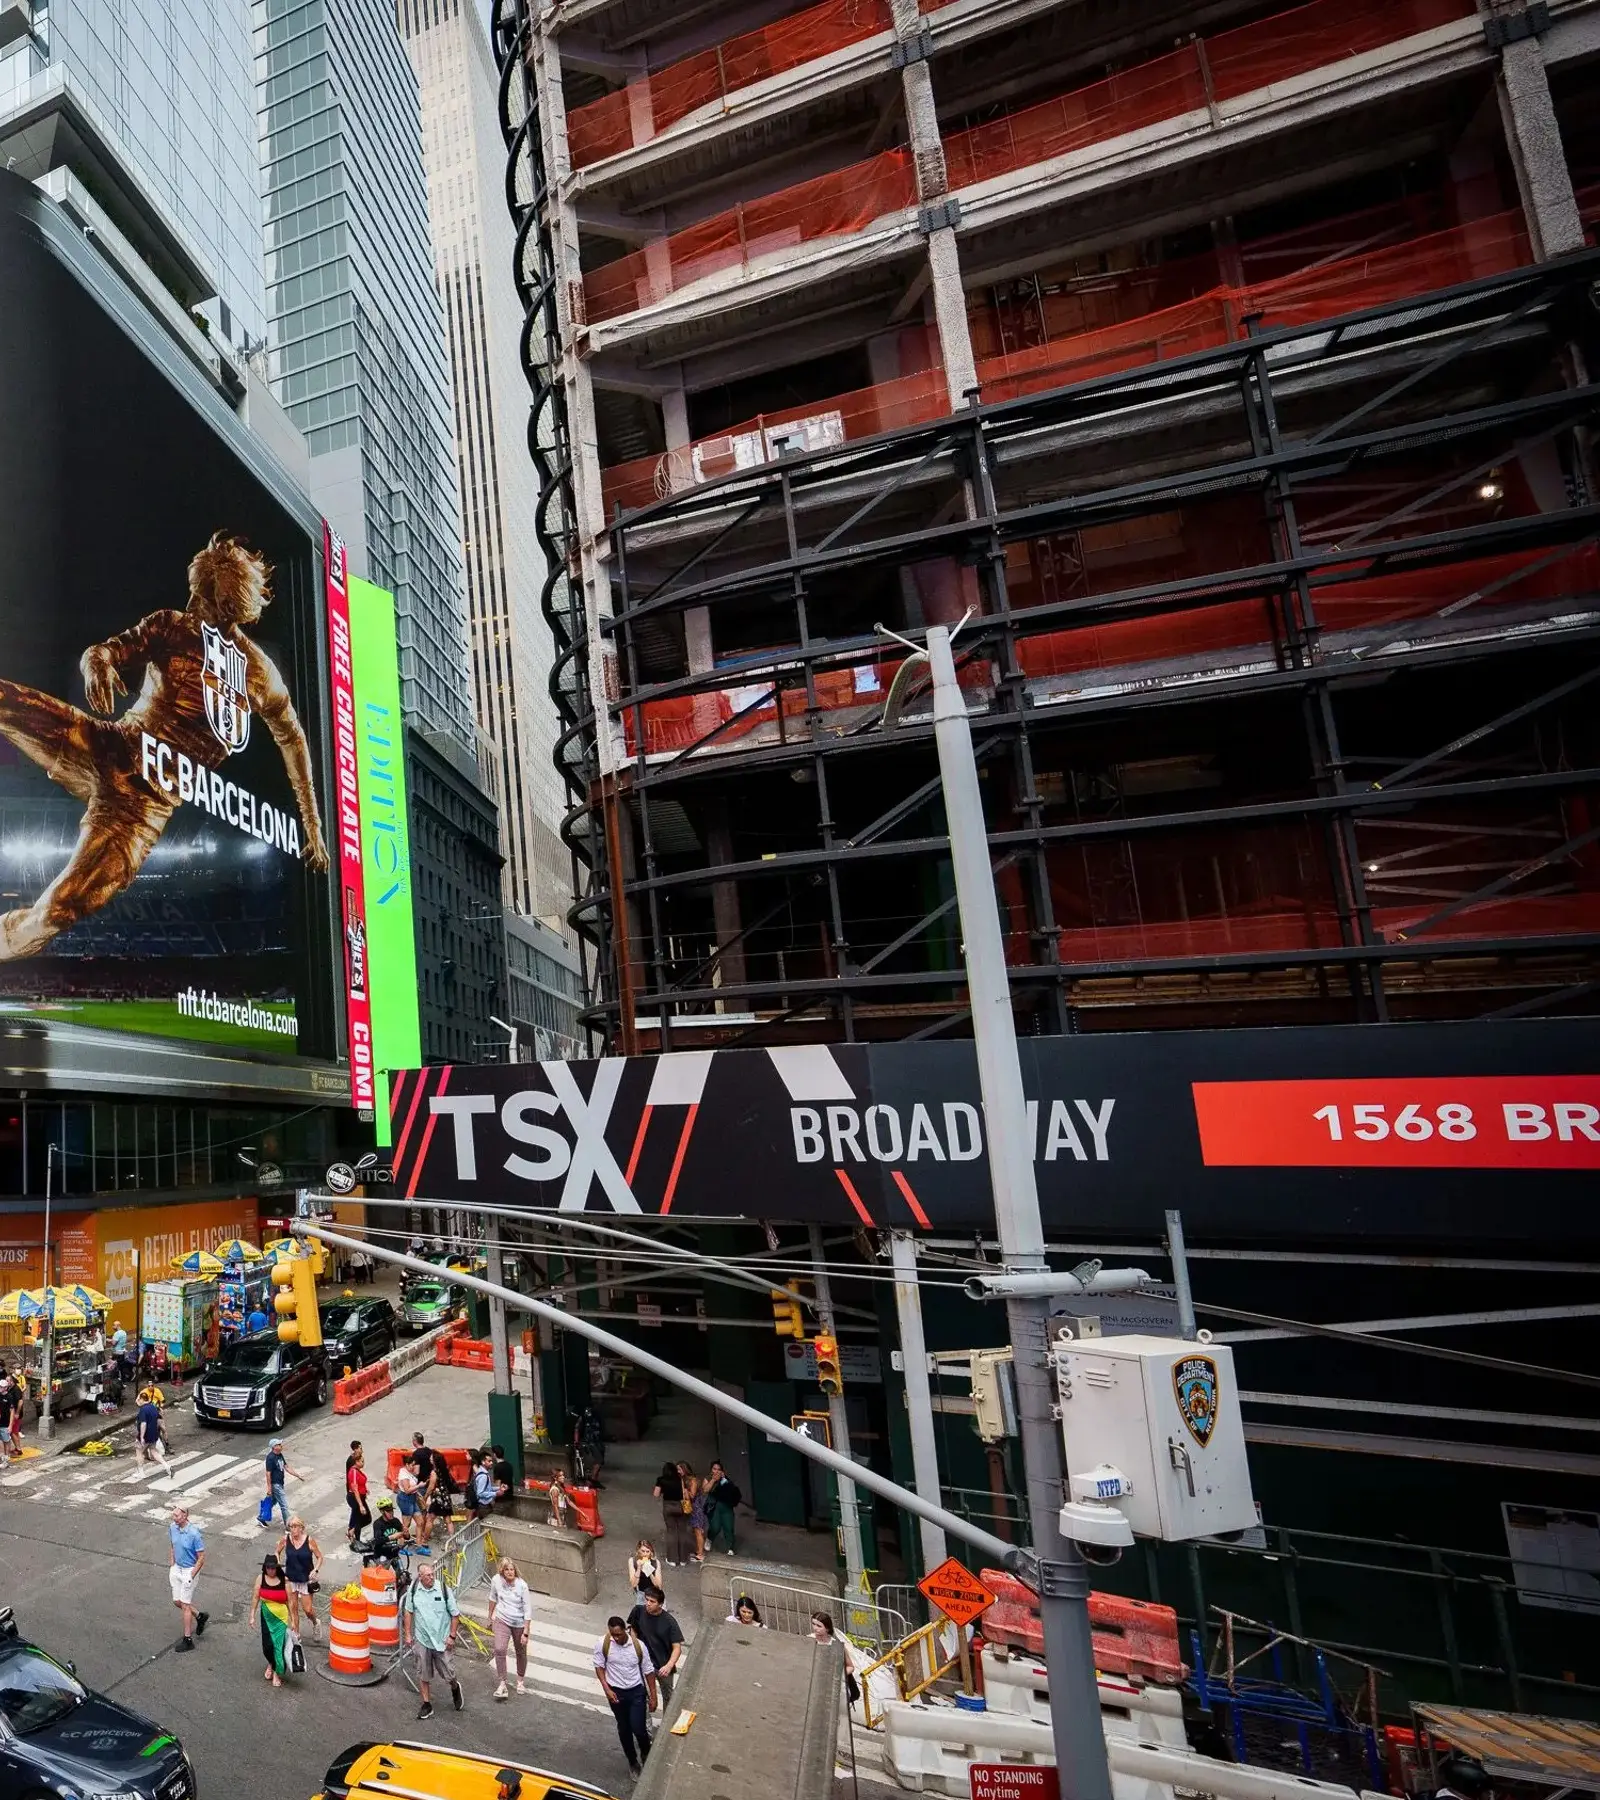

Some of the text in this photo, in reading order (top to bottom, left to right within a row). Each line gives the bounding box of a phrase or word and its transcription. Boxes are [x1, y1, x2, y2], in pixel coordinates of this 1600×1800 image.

[332, 609, 361, 864] FREE CHOCOLATE
[141, 732, 301, 859] FC BARCELONA
[177, 985, 299, 1037] nft.fcbarcelona.com
[1312, 1103, 1477, 1142] 1568
[429, 1057, 644, 1214] TSX
[17, 1250, 29, 1262] SF
[144, 1232, 184, 1270] RETAIL
[121, 1286, 132, 1296] AVE
[55, 1319, 86, 1327] SABRETT
[1120, 1315, 1173, 1325] McGOVERN
[1182, 1361, 1206, 1372] POLICE
[1178, 1370, 1215, 1386] DEPARTMENT
[1205, 1415, 1215, 1434] NEW
[1097, 1479, 1121, 1497] NYPD
[933, 1587, 981, 1601] WORK ZONE
[945, 1602, 972, 1614] AHEAD
[974, 1770, 1044, 1785] NO STANDING
[976, 1785, 1020, 1800] Anytime
